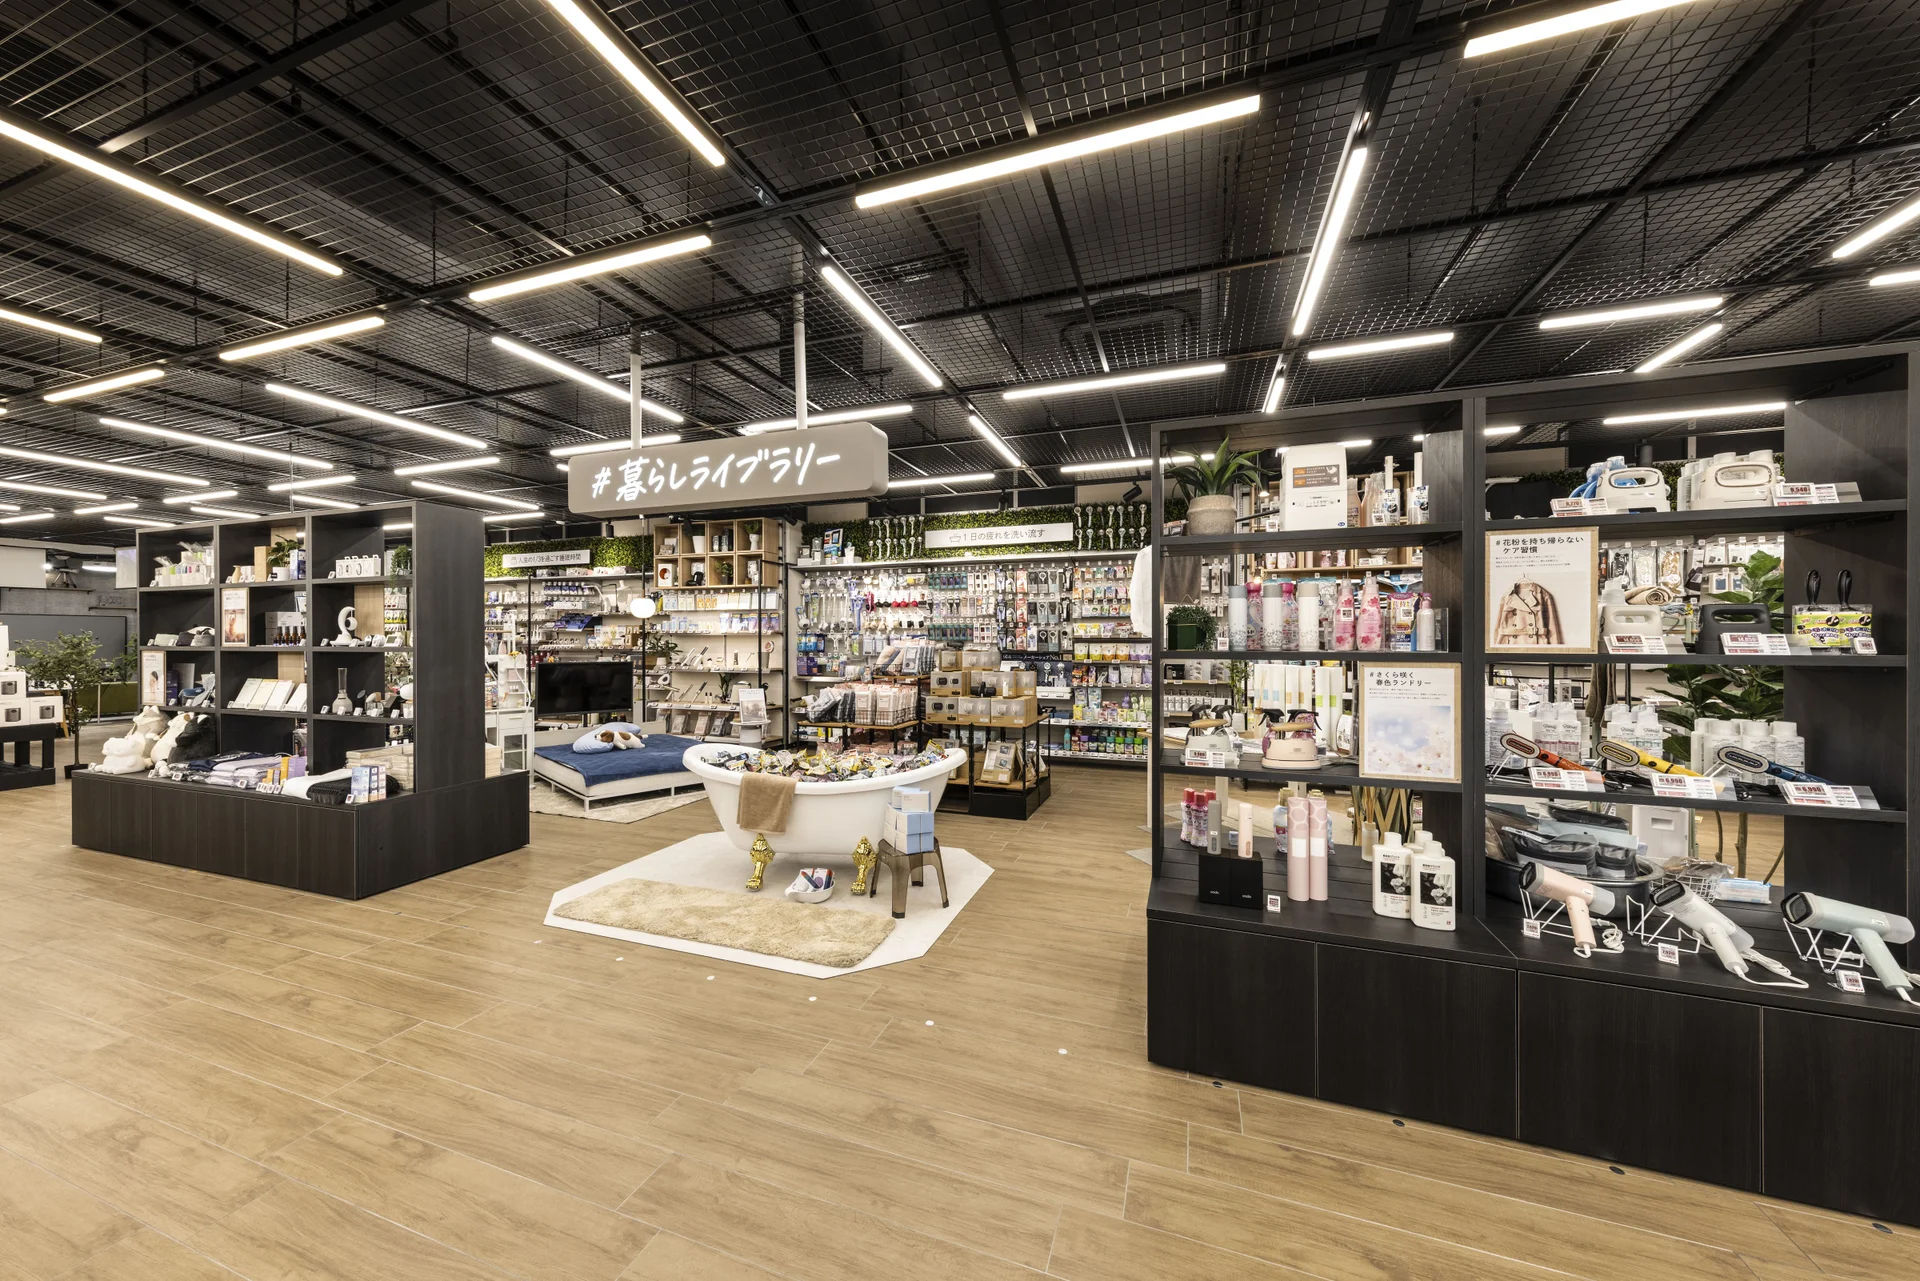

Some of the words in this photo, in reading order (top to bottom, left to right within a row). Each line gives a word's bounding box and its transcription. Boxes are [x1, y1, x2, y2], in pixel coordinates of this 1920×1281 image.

[1503, 546, 1538, 554] ケア習慣
[1376, 679, 1431, 687] 春色ランドリー
